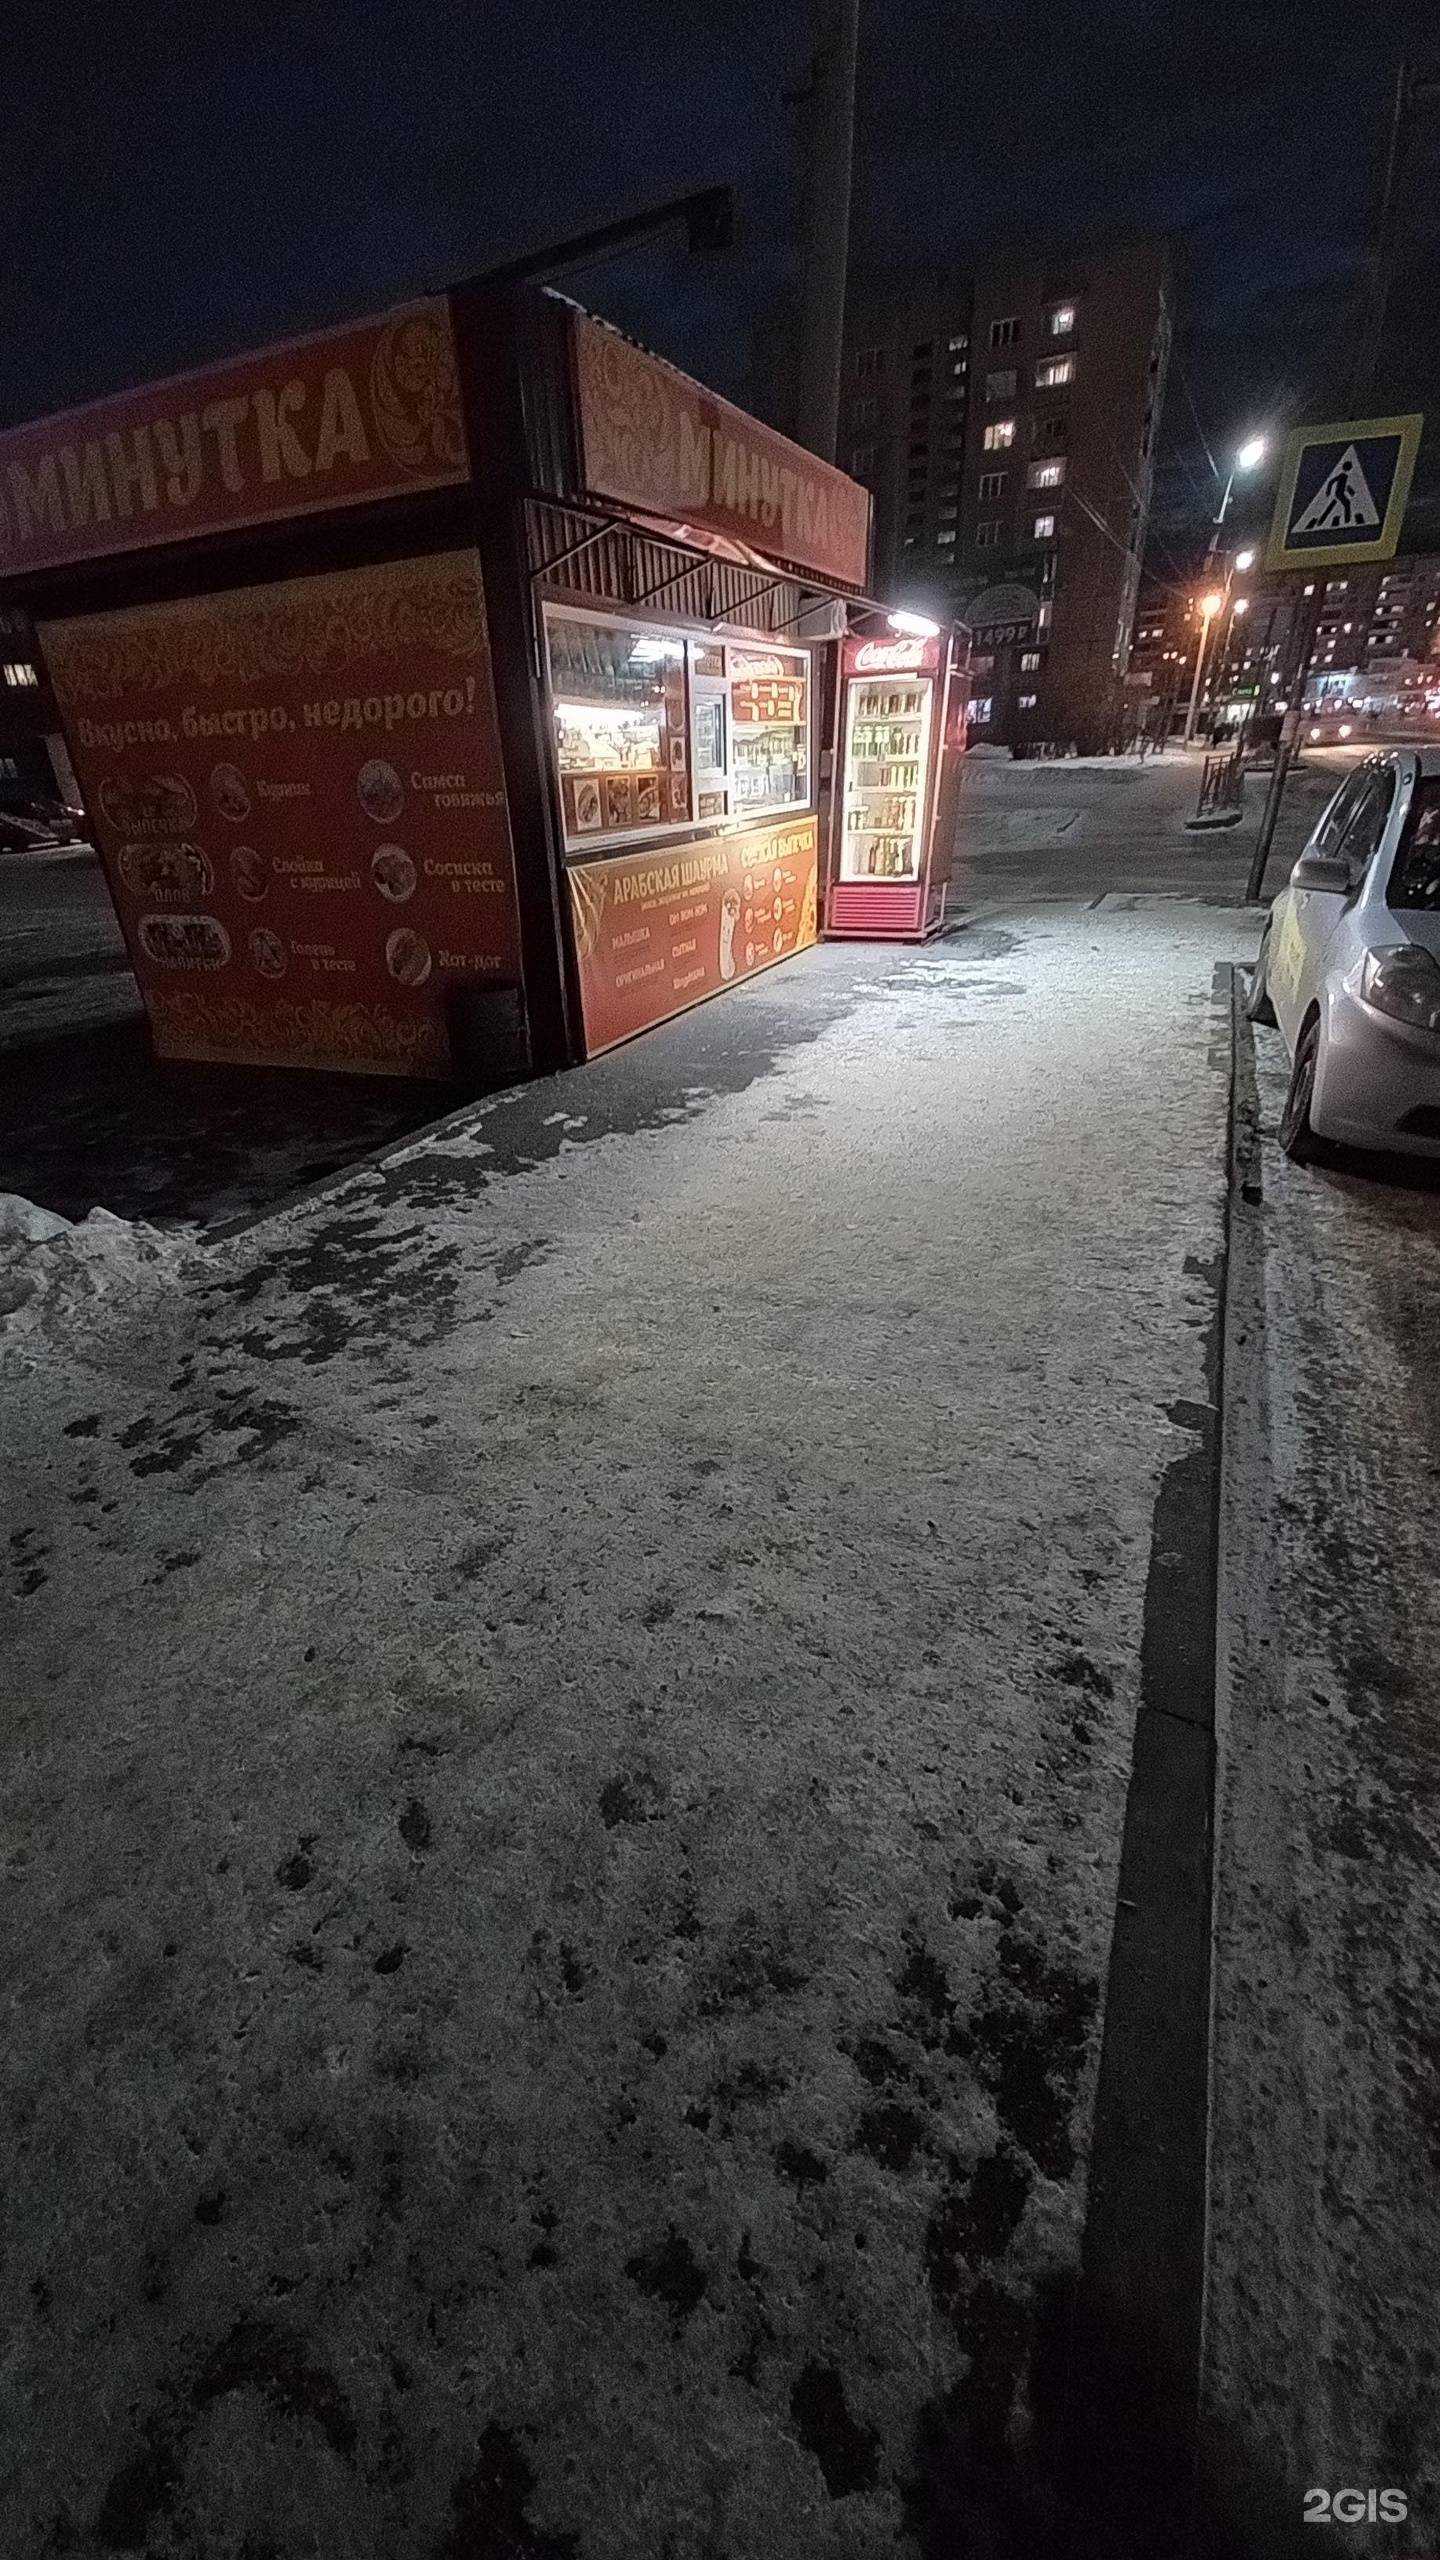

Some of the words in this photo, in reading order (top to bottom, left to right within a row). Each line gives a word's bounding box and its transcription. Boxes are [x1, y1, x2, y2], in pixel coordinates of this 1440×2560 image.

[7, 368, 371, 541] МИНУТКА
[78, 716, 178, 753] Вкусно,
[182, 705, 297, 741] быстро,
[303, 676, 477, 731] недорого!
[423, 858, 494, 876] Сосиска
[613, 863, 680, 905] АРАБСКАЯ
[681, 853, 729, 886] ШАУРМА
